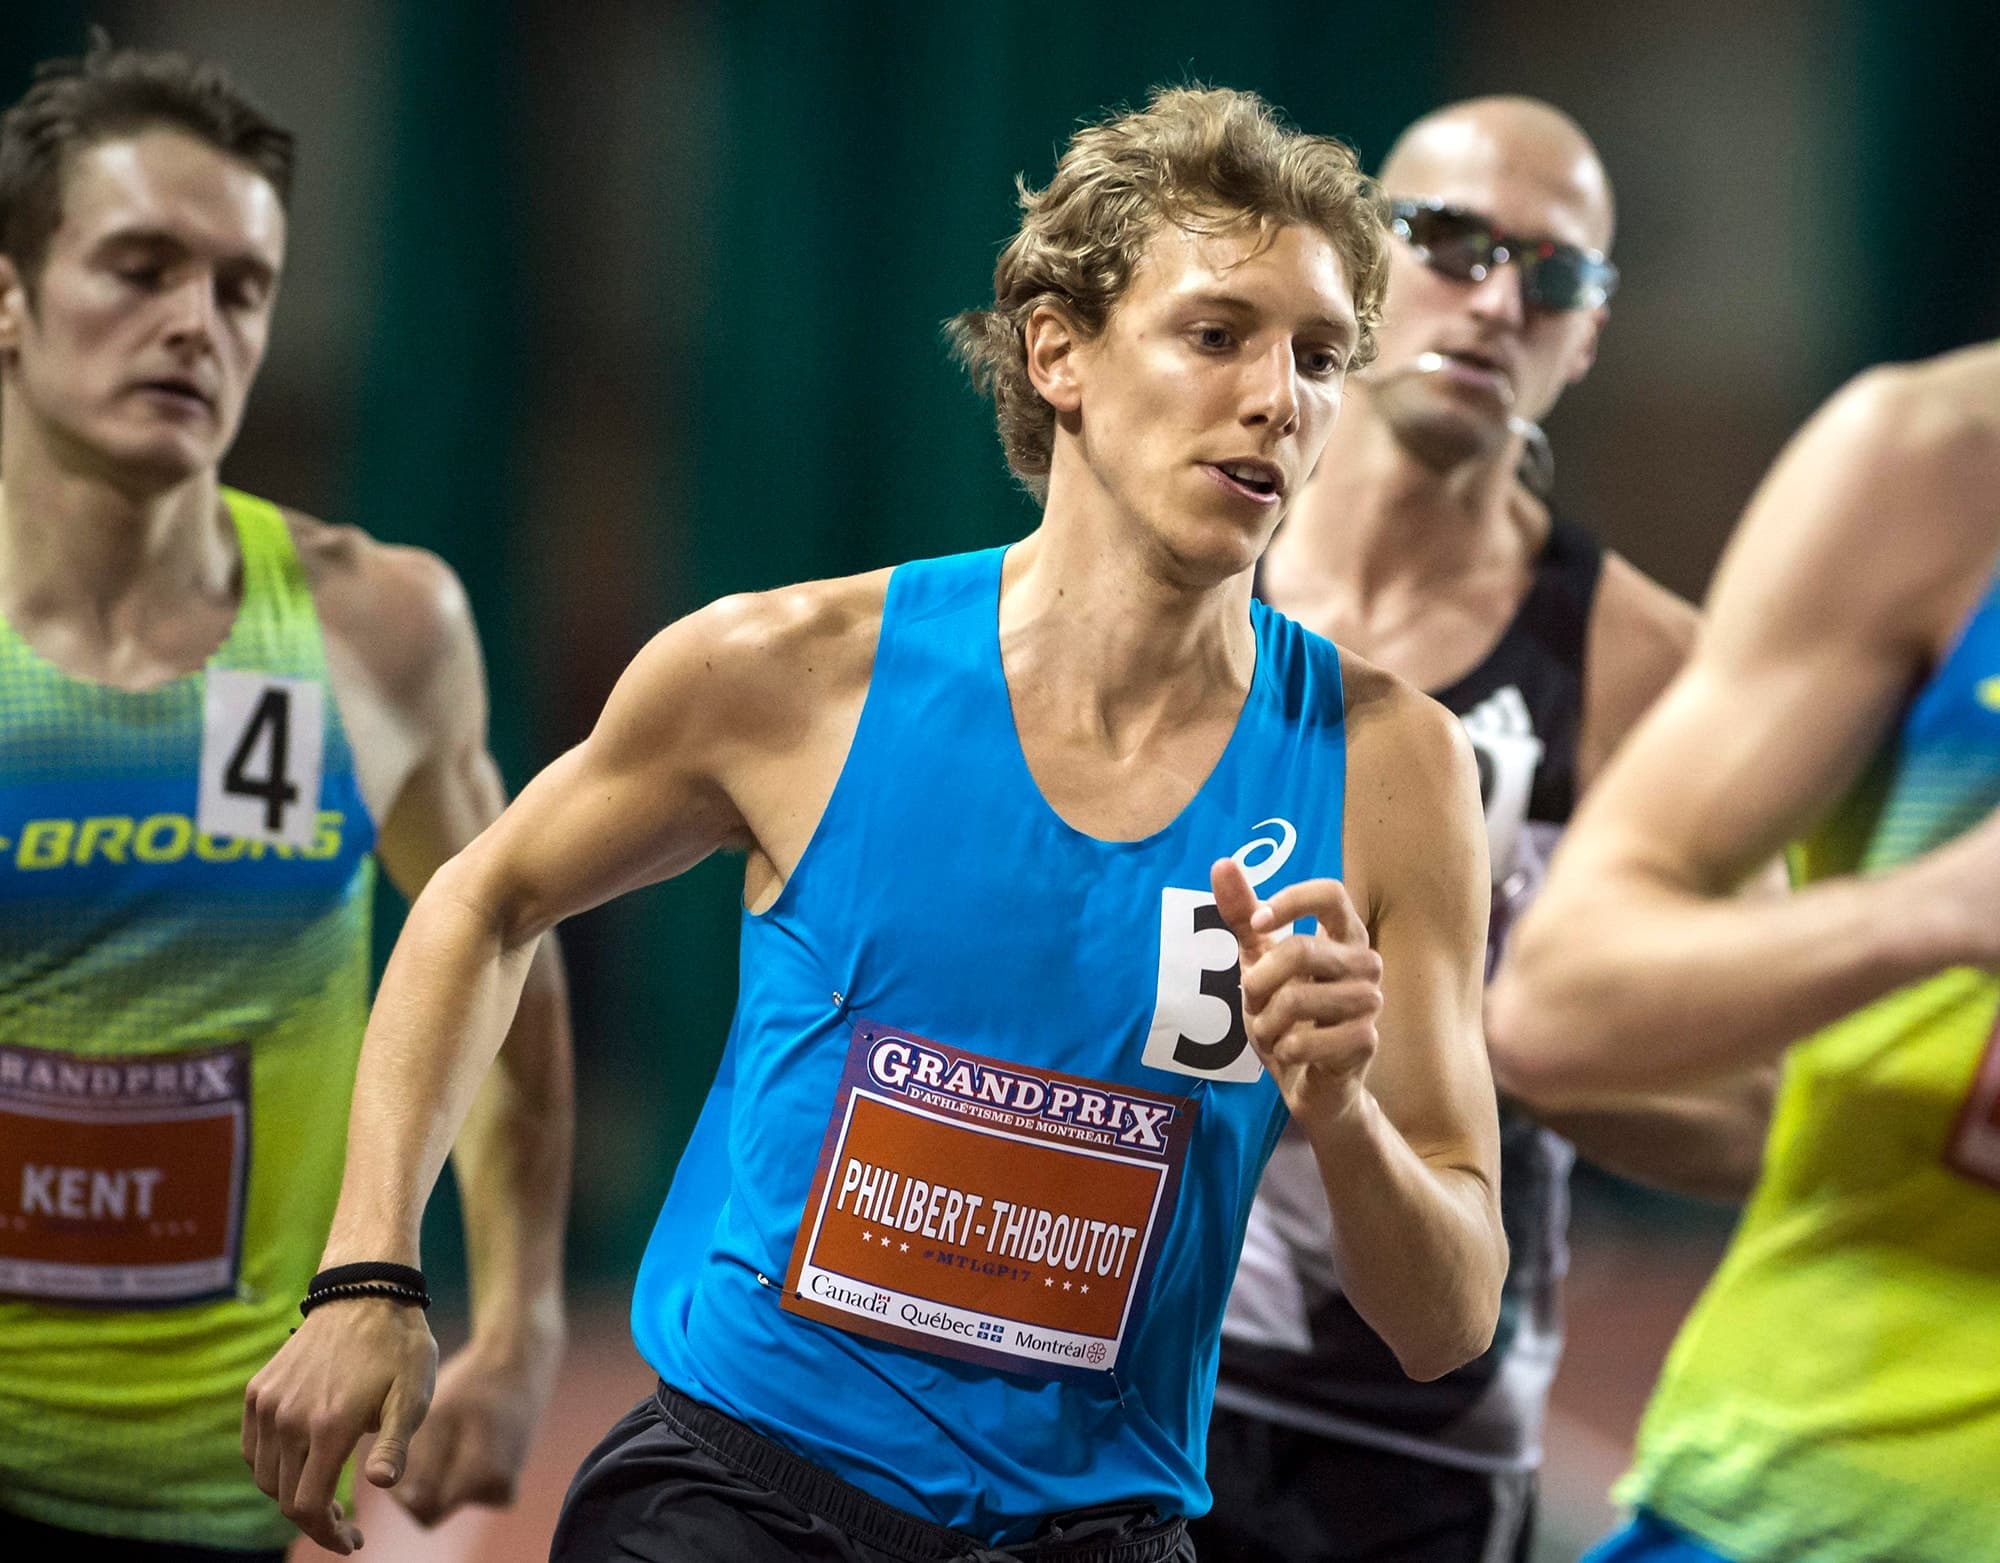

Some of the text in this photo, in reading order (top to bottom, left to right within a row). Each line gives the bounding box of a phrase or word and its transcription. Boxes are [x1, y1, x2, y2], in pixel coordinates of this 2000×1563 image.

[223, 685, 298, 833] 4
[1172, 903, 1249, 1071] 3
[1014, 1116, 1034, 1129] DE
[22, 1165, 163, 1217] KENT
[836, 1159, 1137, 1279] PHILIBERT-THIBOUTOT
[811, 1274, 1087, 1360] Canada Québec Montréal
